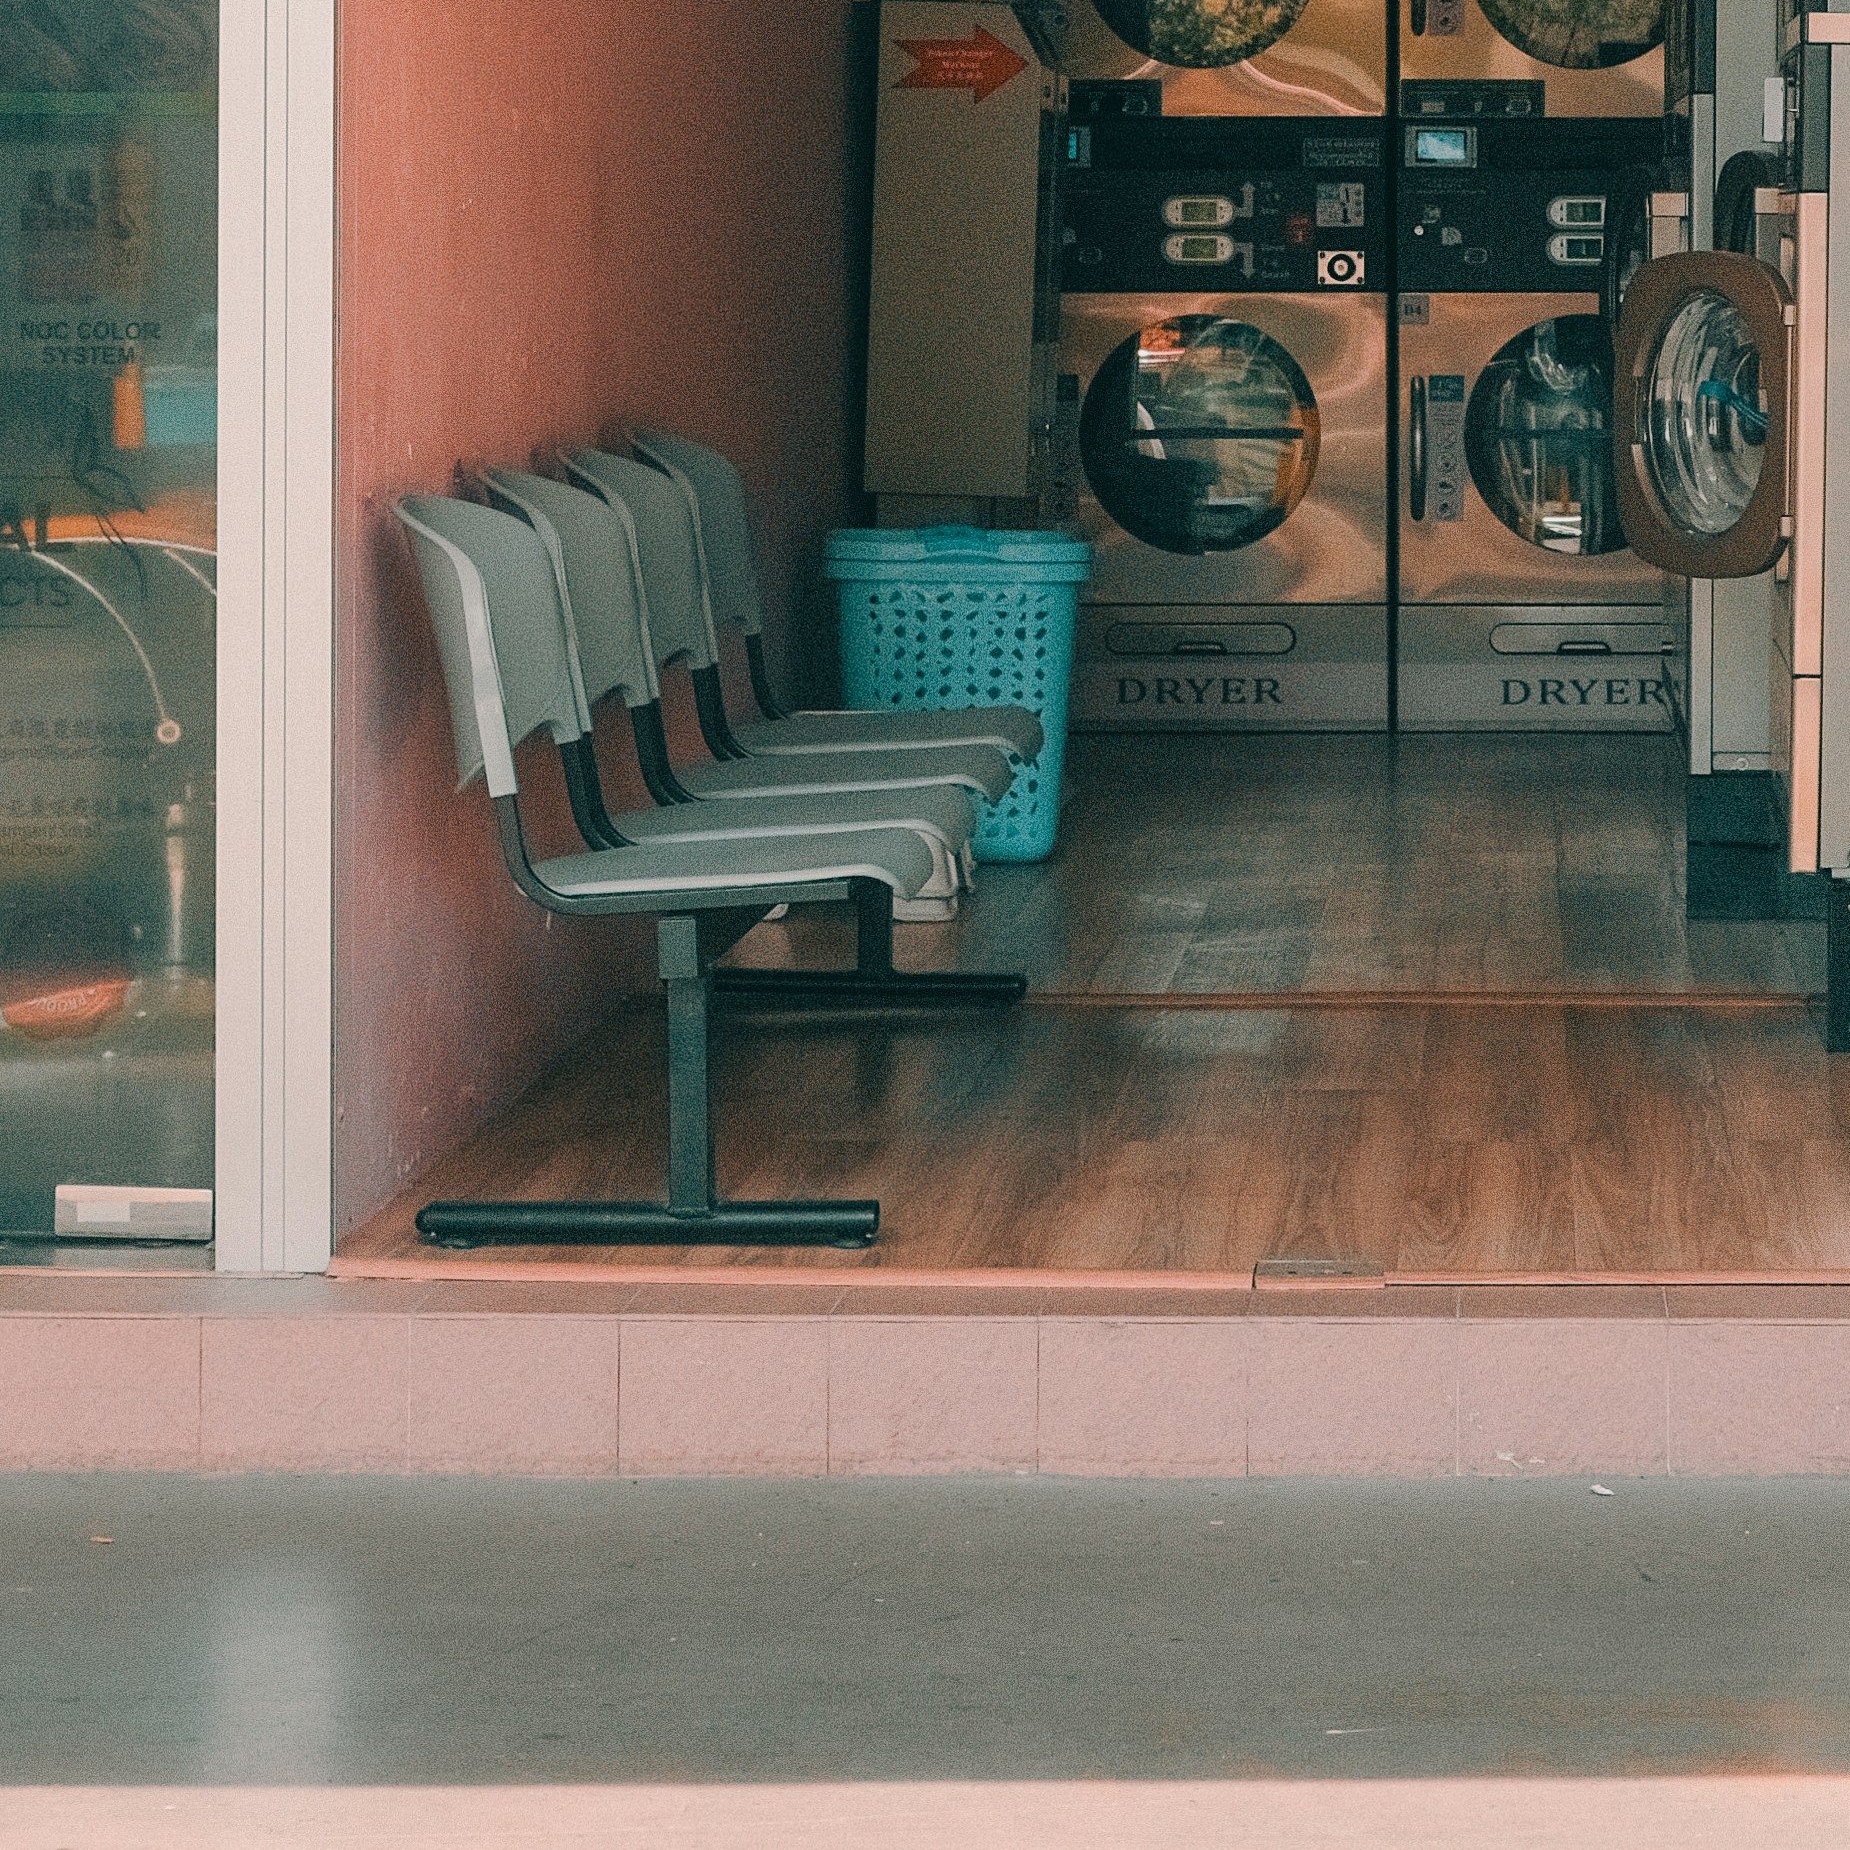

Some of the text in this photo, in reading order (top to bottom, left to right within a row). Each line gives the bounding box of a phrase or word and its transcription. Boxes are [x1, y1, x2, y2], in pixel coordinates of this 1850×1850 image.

[77, 320, 162, 341] COLOR
[42, 345, 137, 366] SYSTEM
[1117, 677, 1283, 705] DRYER
[1501, 677, 1667, 706] DRYER
